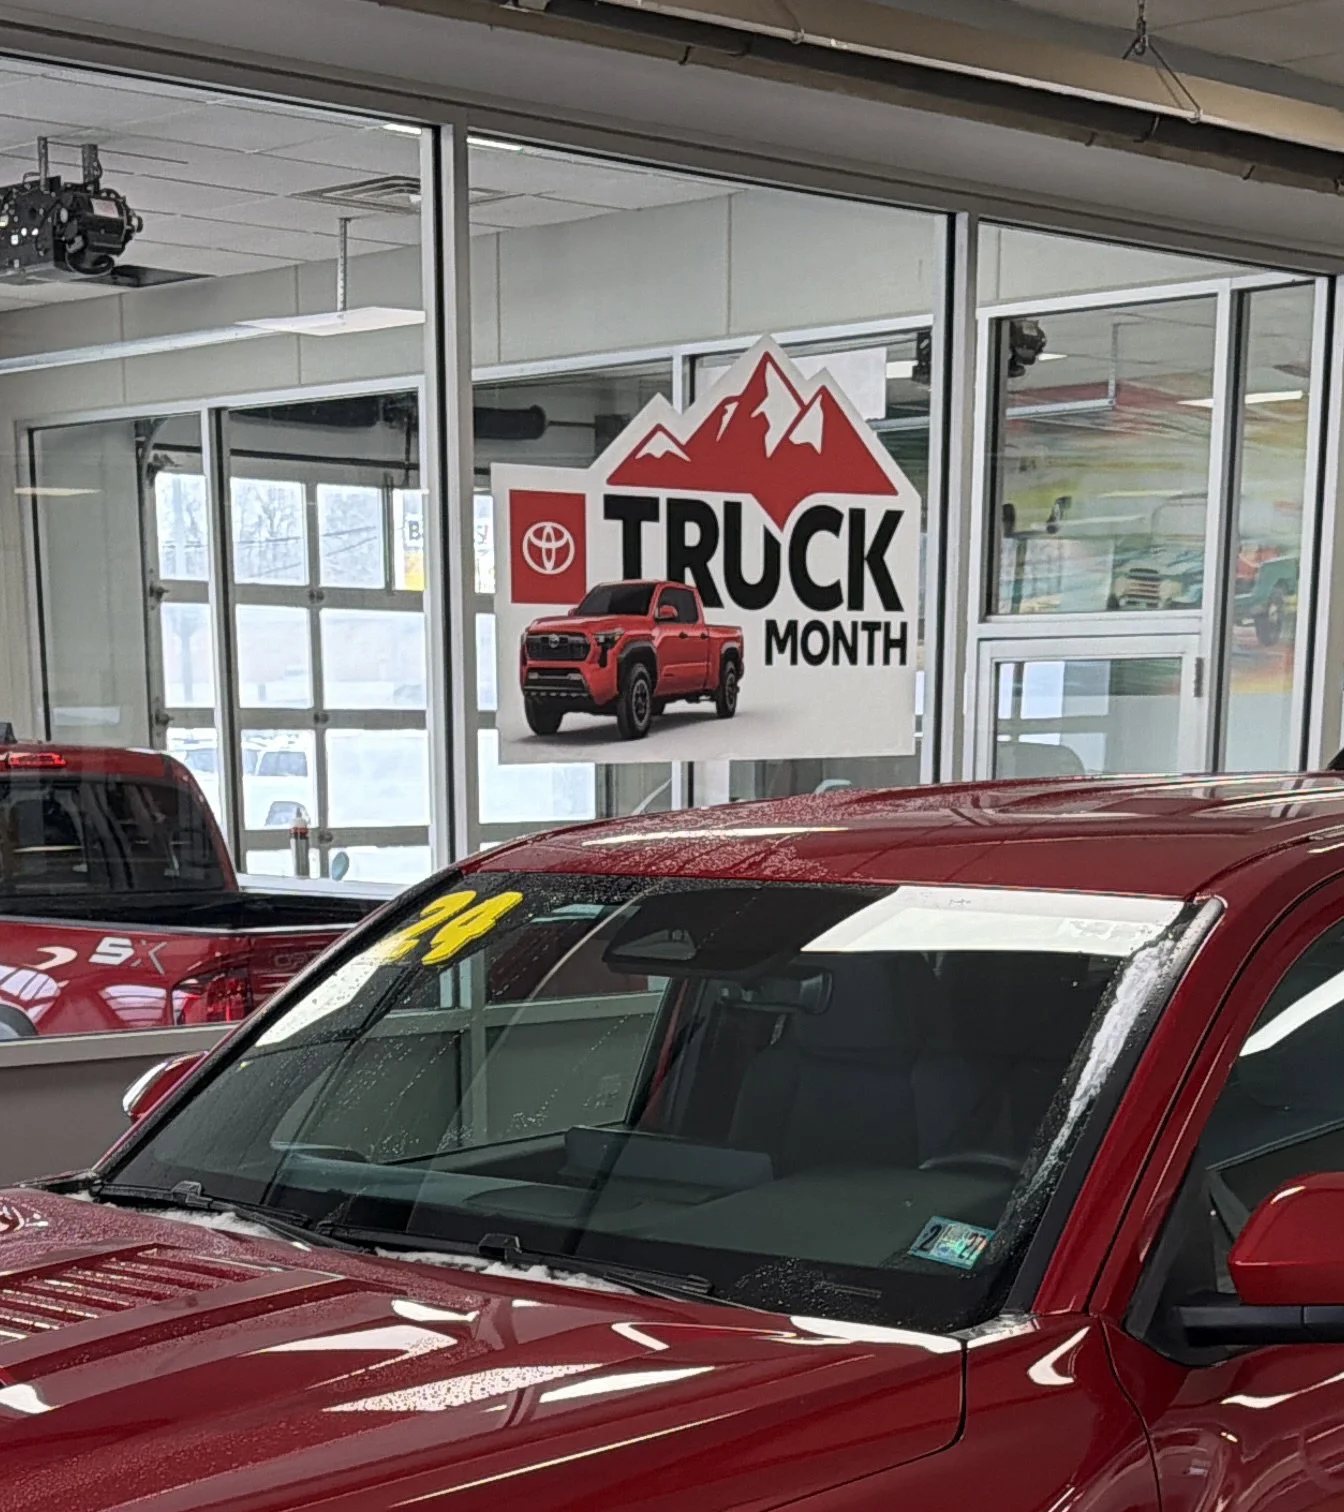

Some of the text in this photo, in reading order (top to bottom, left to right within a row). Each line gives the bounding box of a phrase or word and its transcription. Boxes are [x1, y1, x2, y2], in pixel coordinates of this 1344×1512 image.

[603, 494, 905, 612] TRUCK
[764, 619, 908, 667] MONTH
[377, 890, 524, 966] 24
